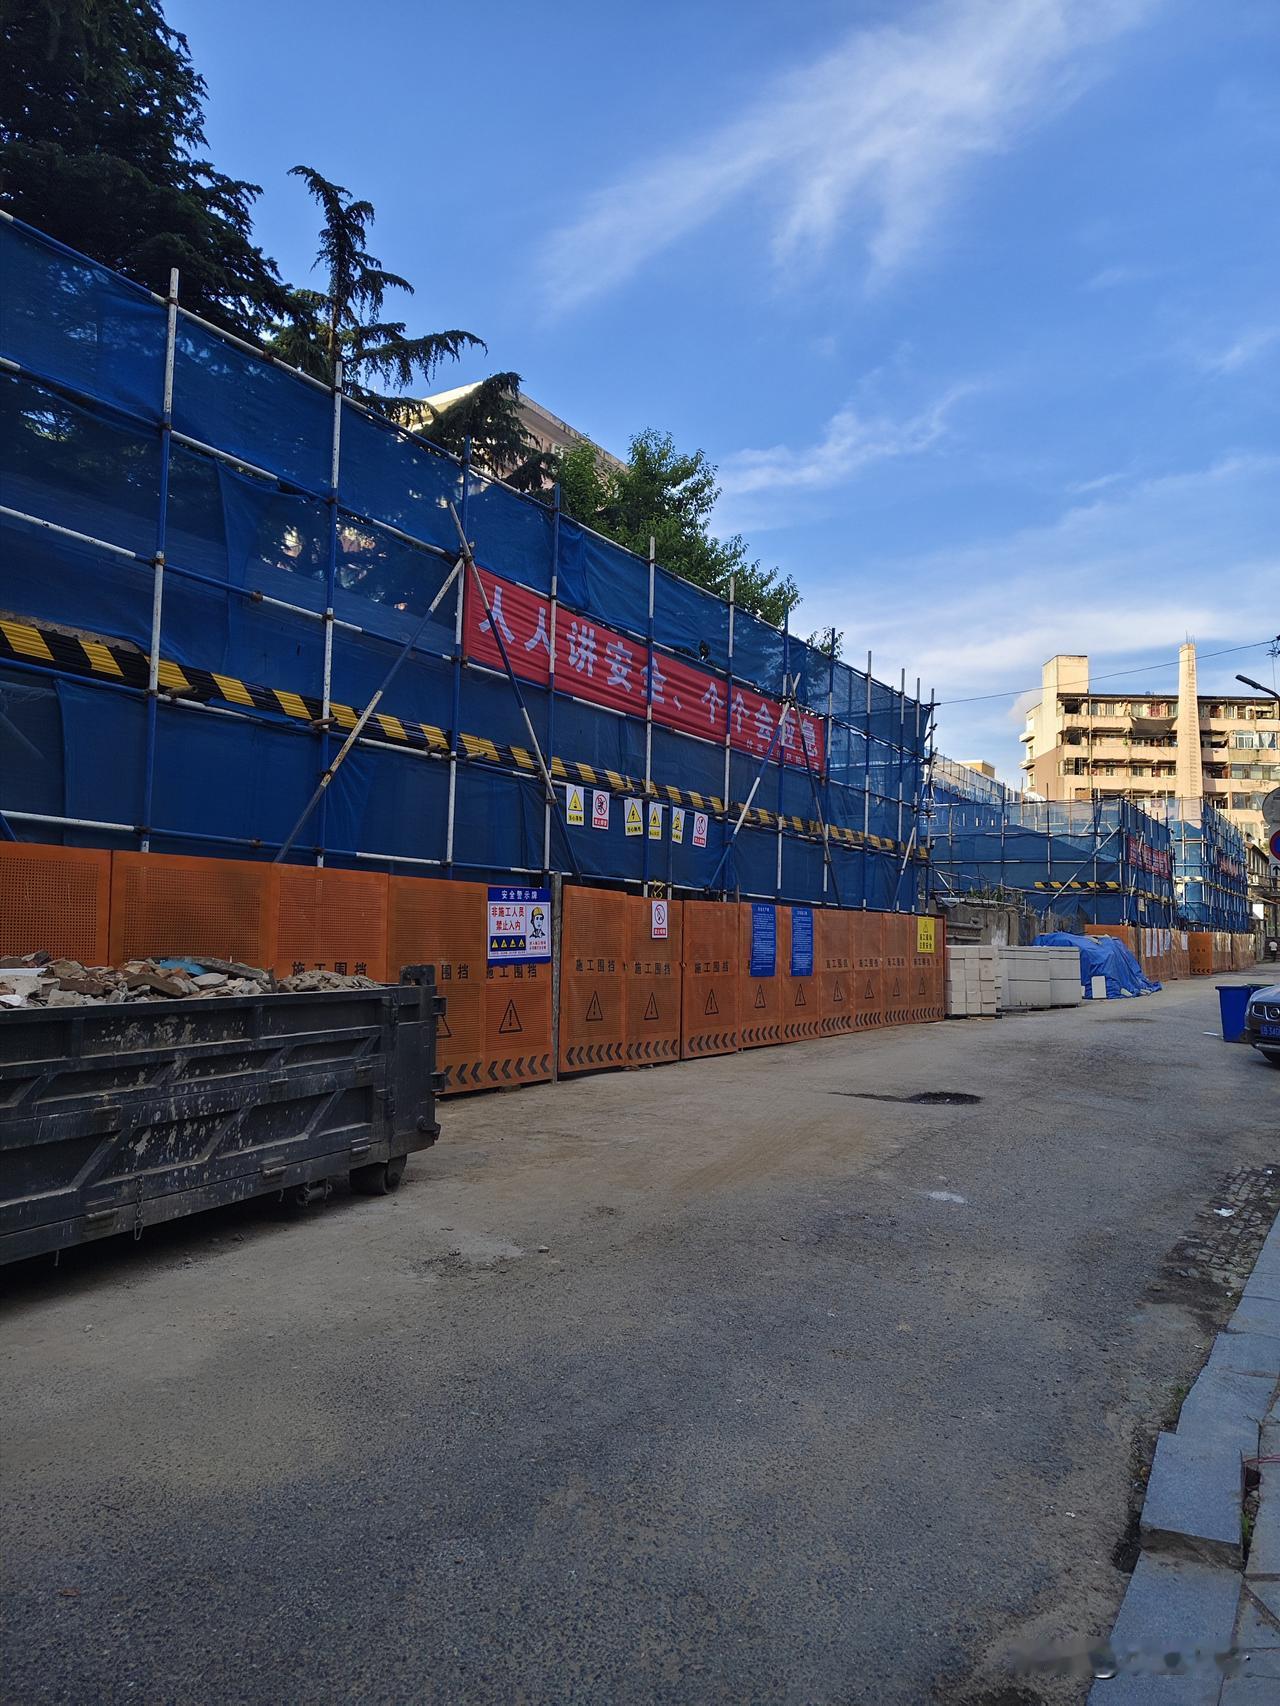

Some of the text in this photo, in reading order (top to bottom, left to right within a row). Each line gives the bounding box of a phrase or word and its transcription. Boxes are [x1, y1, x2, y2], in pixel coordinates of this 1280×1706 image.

[501, 890, 538, 900] 安全警示牌
[491, 906, 525, 918] 非施工人员
[496, 920, 521, 932] 禁止入内
[575, 959, 615, 972] 施工围挡
[634, 961, 671, 975] 施工围挡
